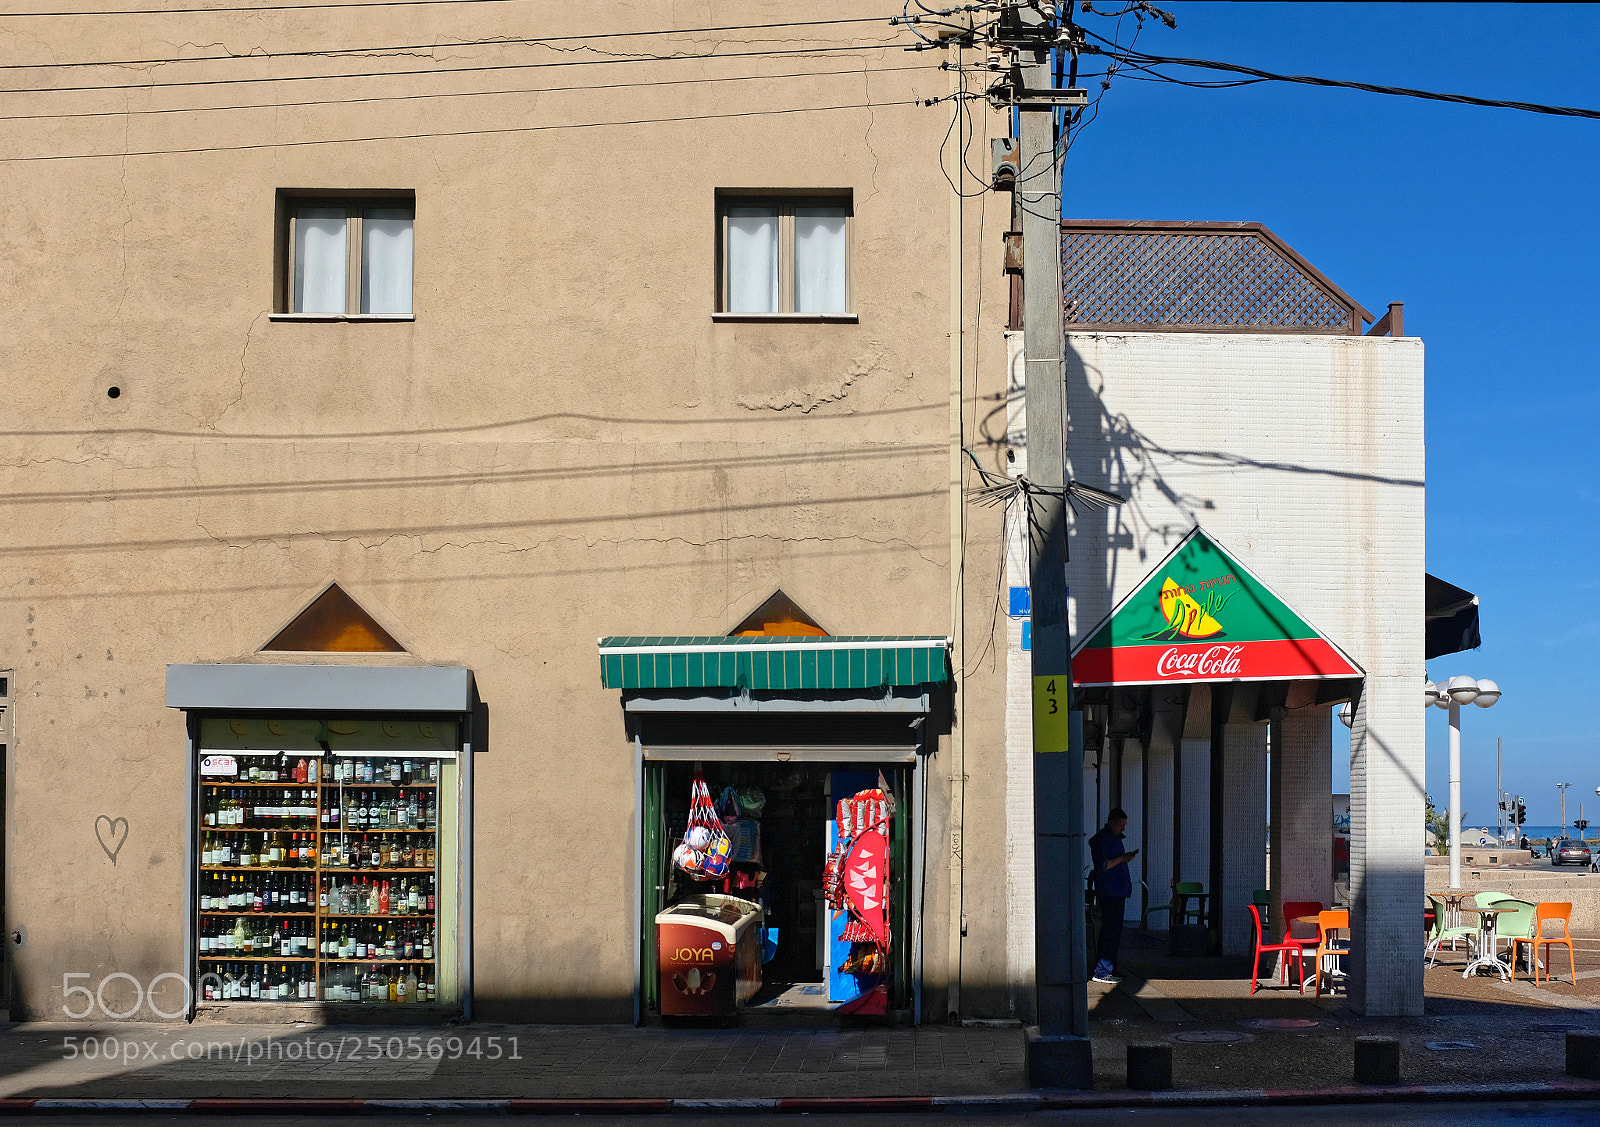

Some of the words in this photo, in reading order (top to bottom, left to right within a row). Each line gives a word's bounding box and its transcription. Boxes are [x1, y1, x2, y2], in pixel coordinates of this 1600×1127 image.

[1199, 574, 1236, 591] חנויות
[1162, 584, 1196, 600] נוחות
[1126, 590, 1241, 641] Apple
[1157, 645, 1246, 677] Coca-Cola
[670, 947, 714, 962] JOYA
